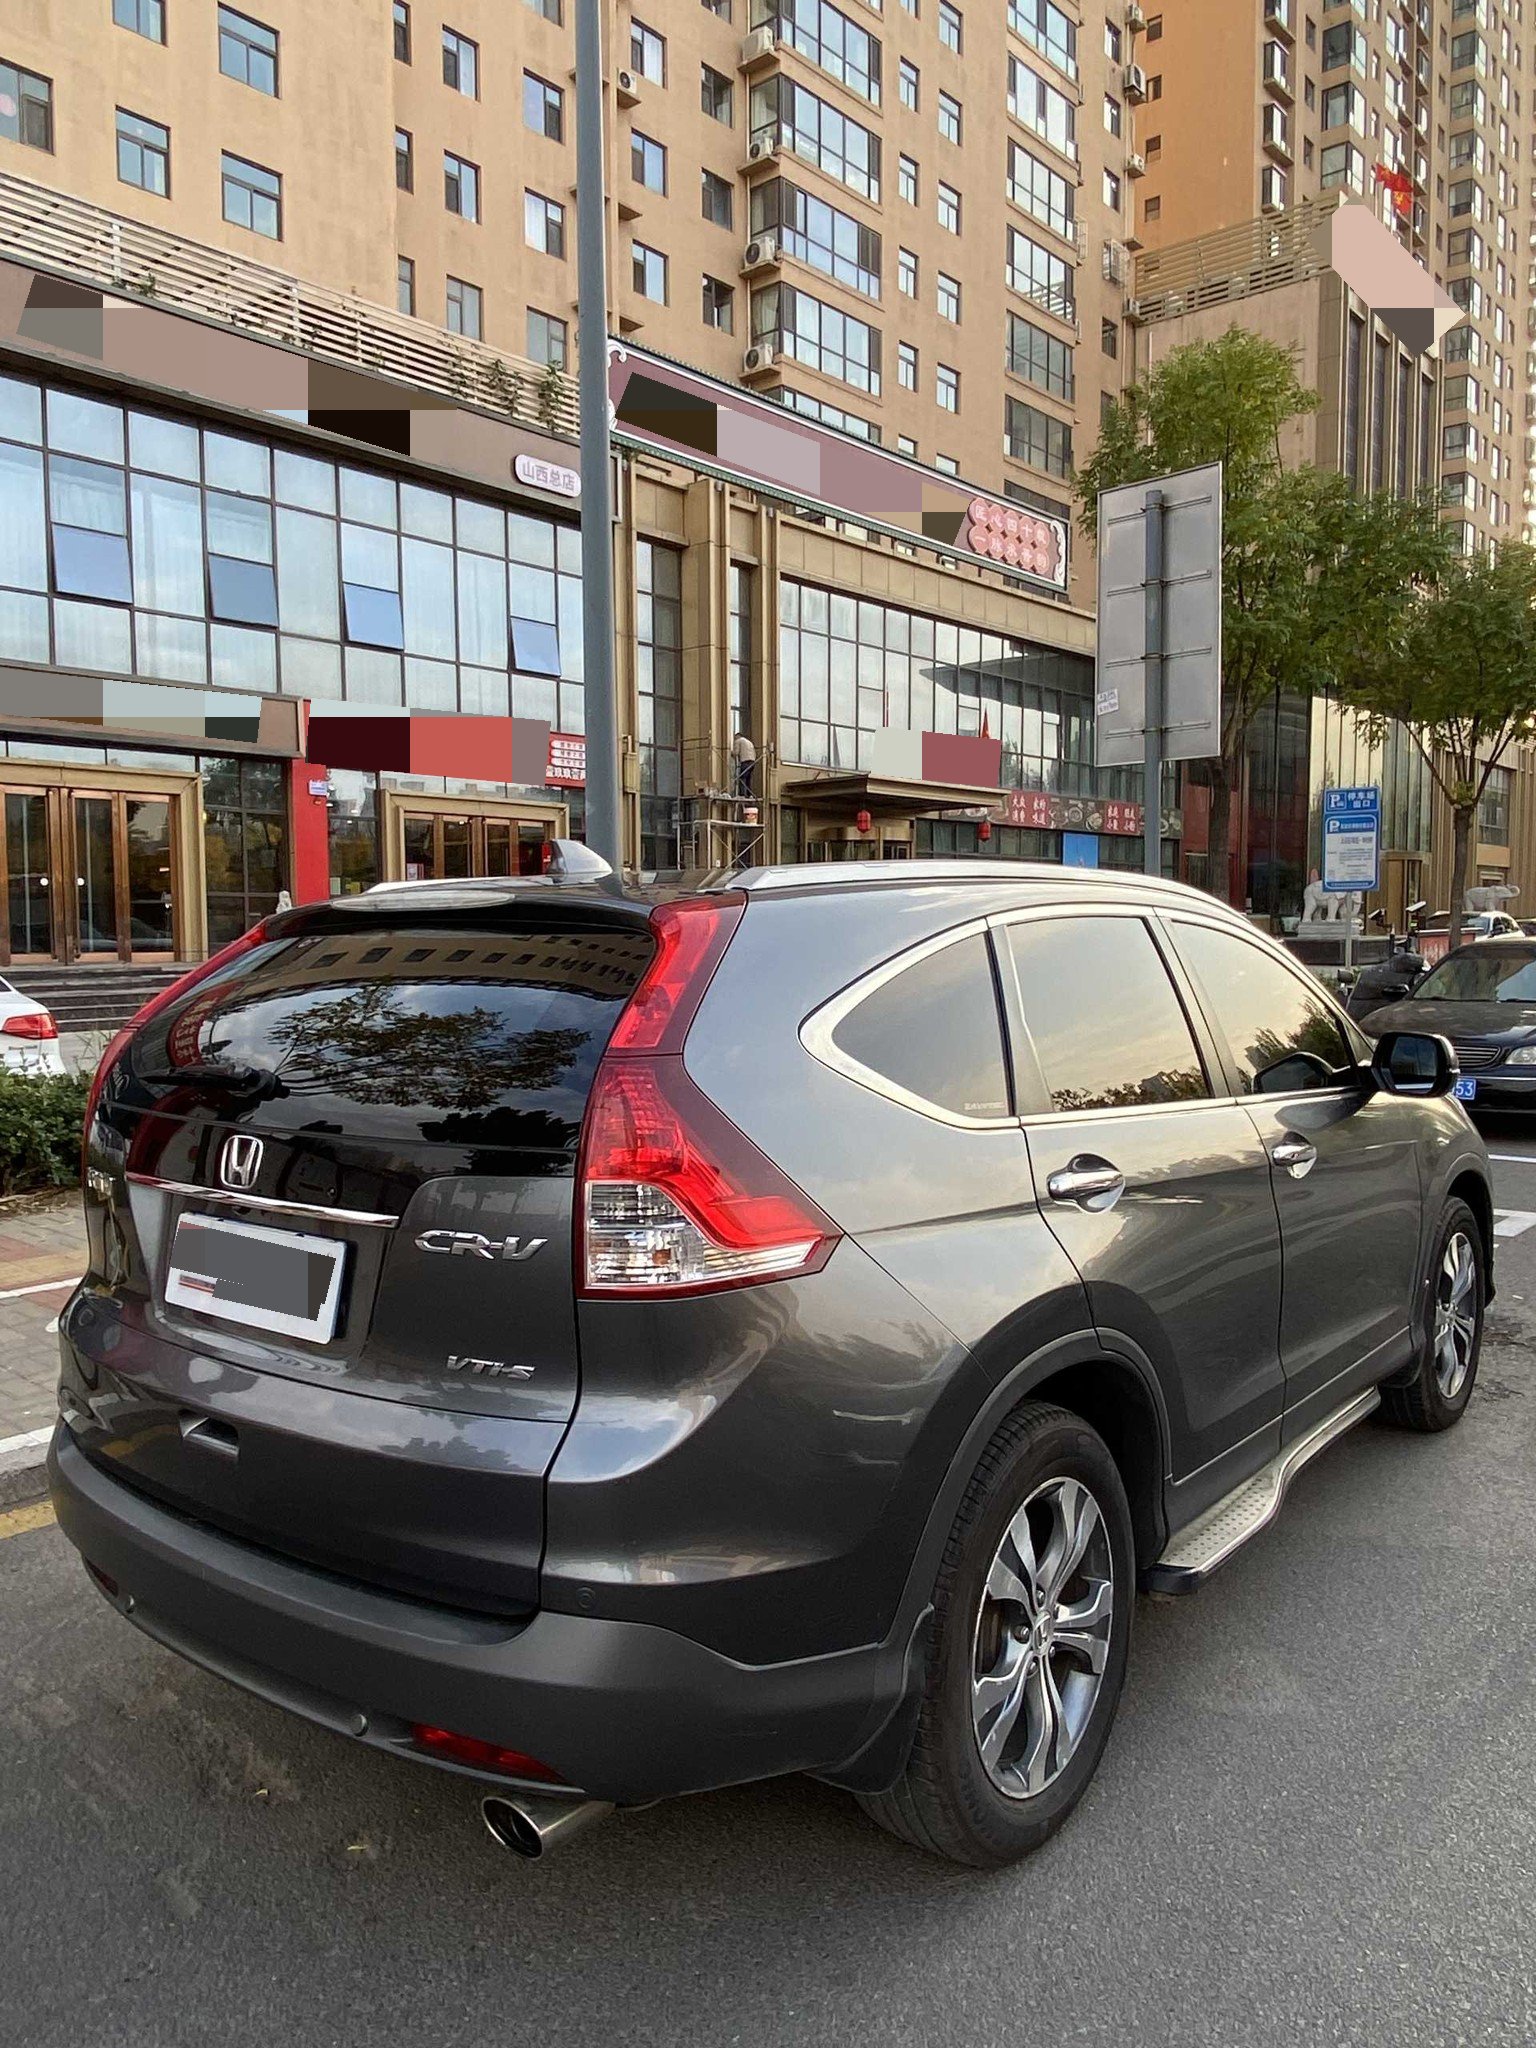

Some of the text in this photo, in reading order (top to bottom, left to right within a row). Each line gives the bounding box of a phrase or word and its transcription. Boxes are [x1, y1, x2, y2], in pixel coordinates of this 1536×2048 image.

[522, 460, 575, 492] 山西总店
[1452, 1081, 1473, 1096] 53
[414, 1230, 548, 1261] CR-V
